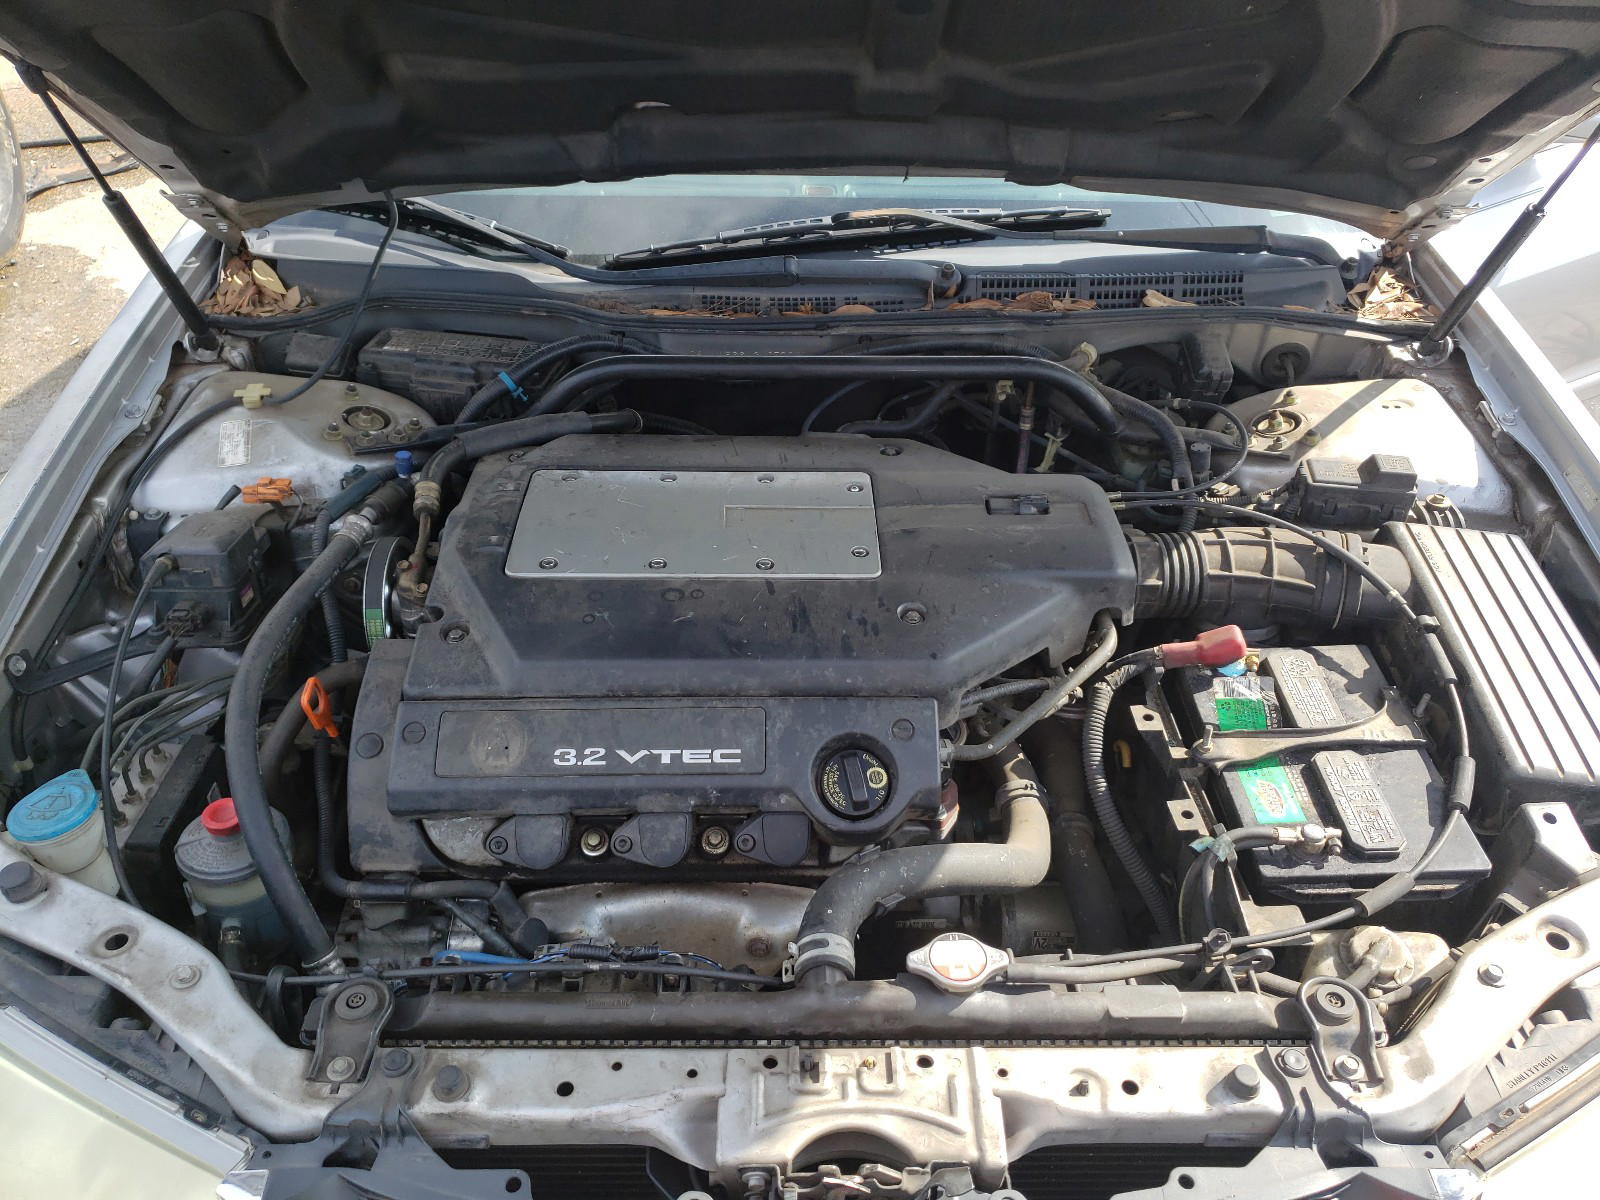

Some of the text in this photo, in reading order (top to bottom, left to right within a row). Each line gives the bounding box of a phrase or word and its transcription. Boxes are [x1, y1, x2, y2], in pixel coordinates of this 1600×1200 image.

[553, 748, 742, 766] 3.2 VTEC
[875, 790, 885, 801] OIL
